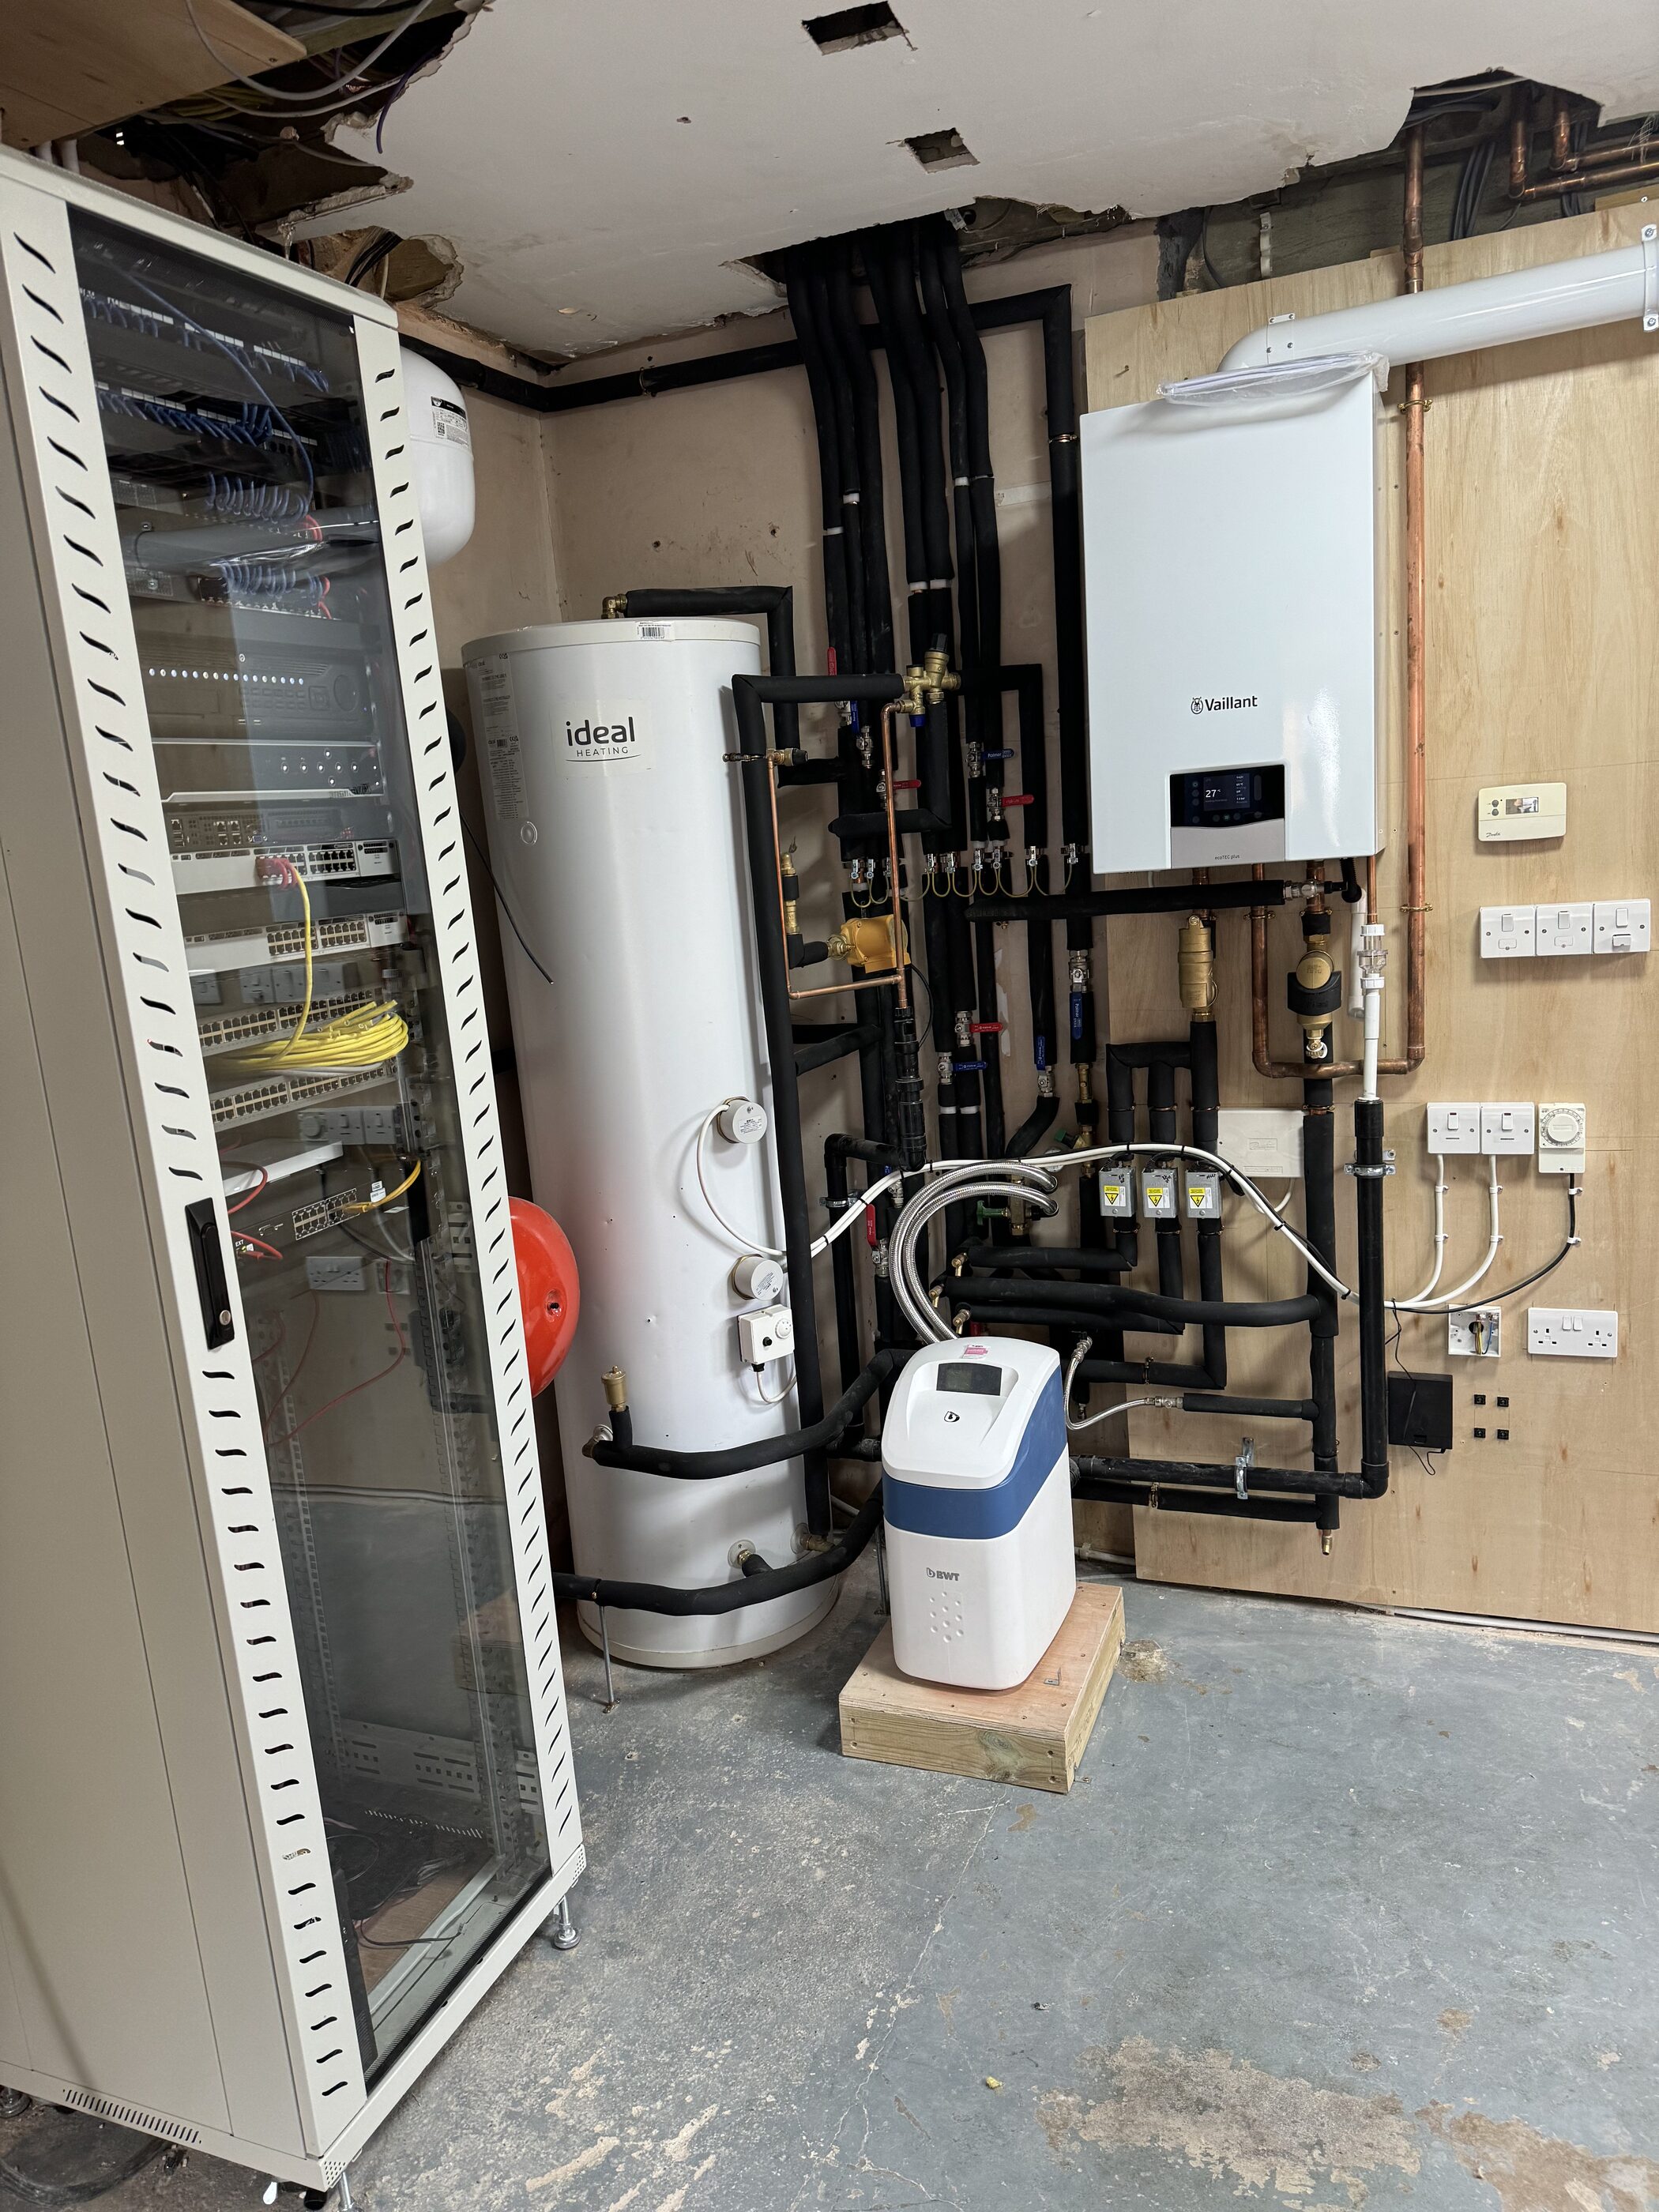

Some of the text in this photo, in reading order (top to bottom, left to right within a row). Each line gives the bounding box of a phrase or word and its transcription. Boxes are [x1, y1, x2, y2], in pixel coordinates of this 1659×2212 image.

[1205, 695, 1258, 711] Vaillant
[566, 717, 635, 746] ideal
[577, 747, 628, 757] HEATING
[936, 1571, 960, 1581] BWT
